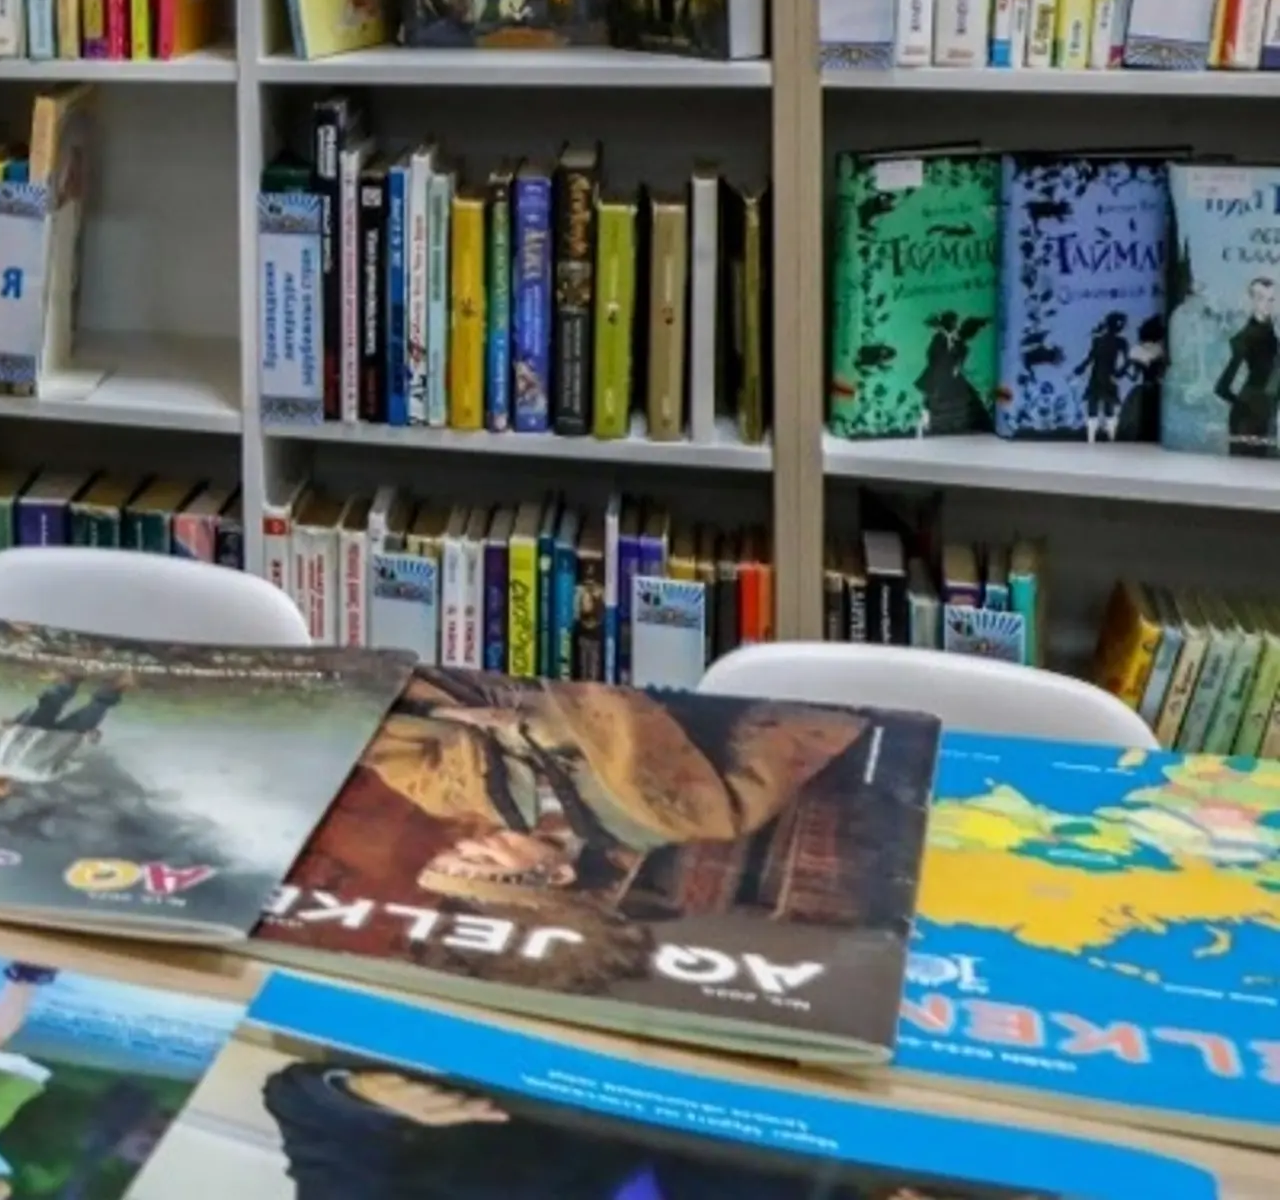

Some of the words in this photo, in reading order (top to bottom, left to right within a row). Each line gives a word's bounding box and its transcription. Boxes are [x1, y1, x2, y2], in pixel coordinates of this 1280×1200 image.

[0, 267, 26, 301] Я
[64, 857, 219, 895] AQ
[262, 884, 583, 959] JELKE
[655, 942, 823, 993] AQ
